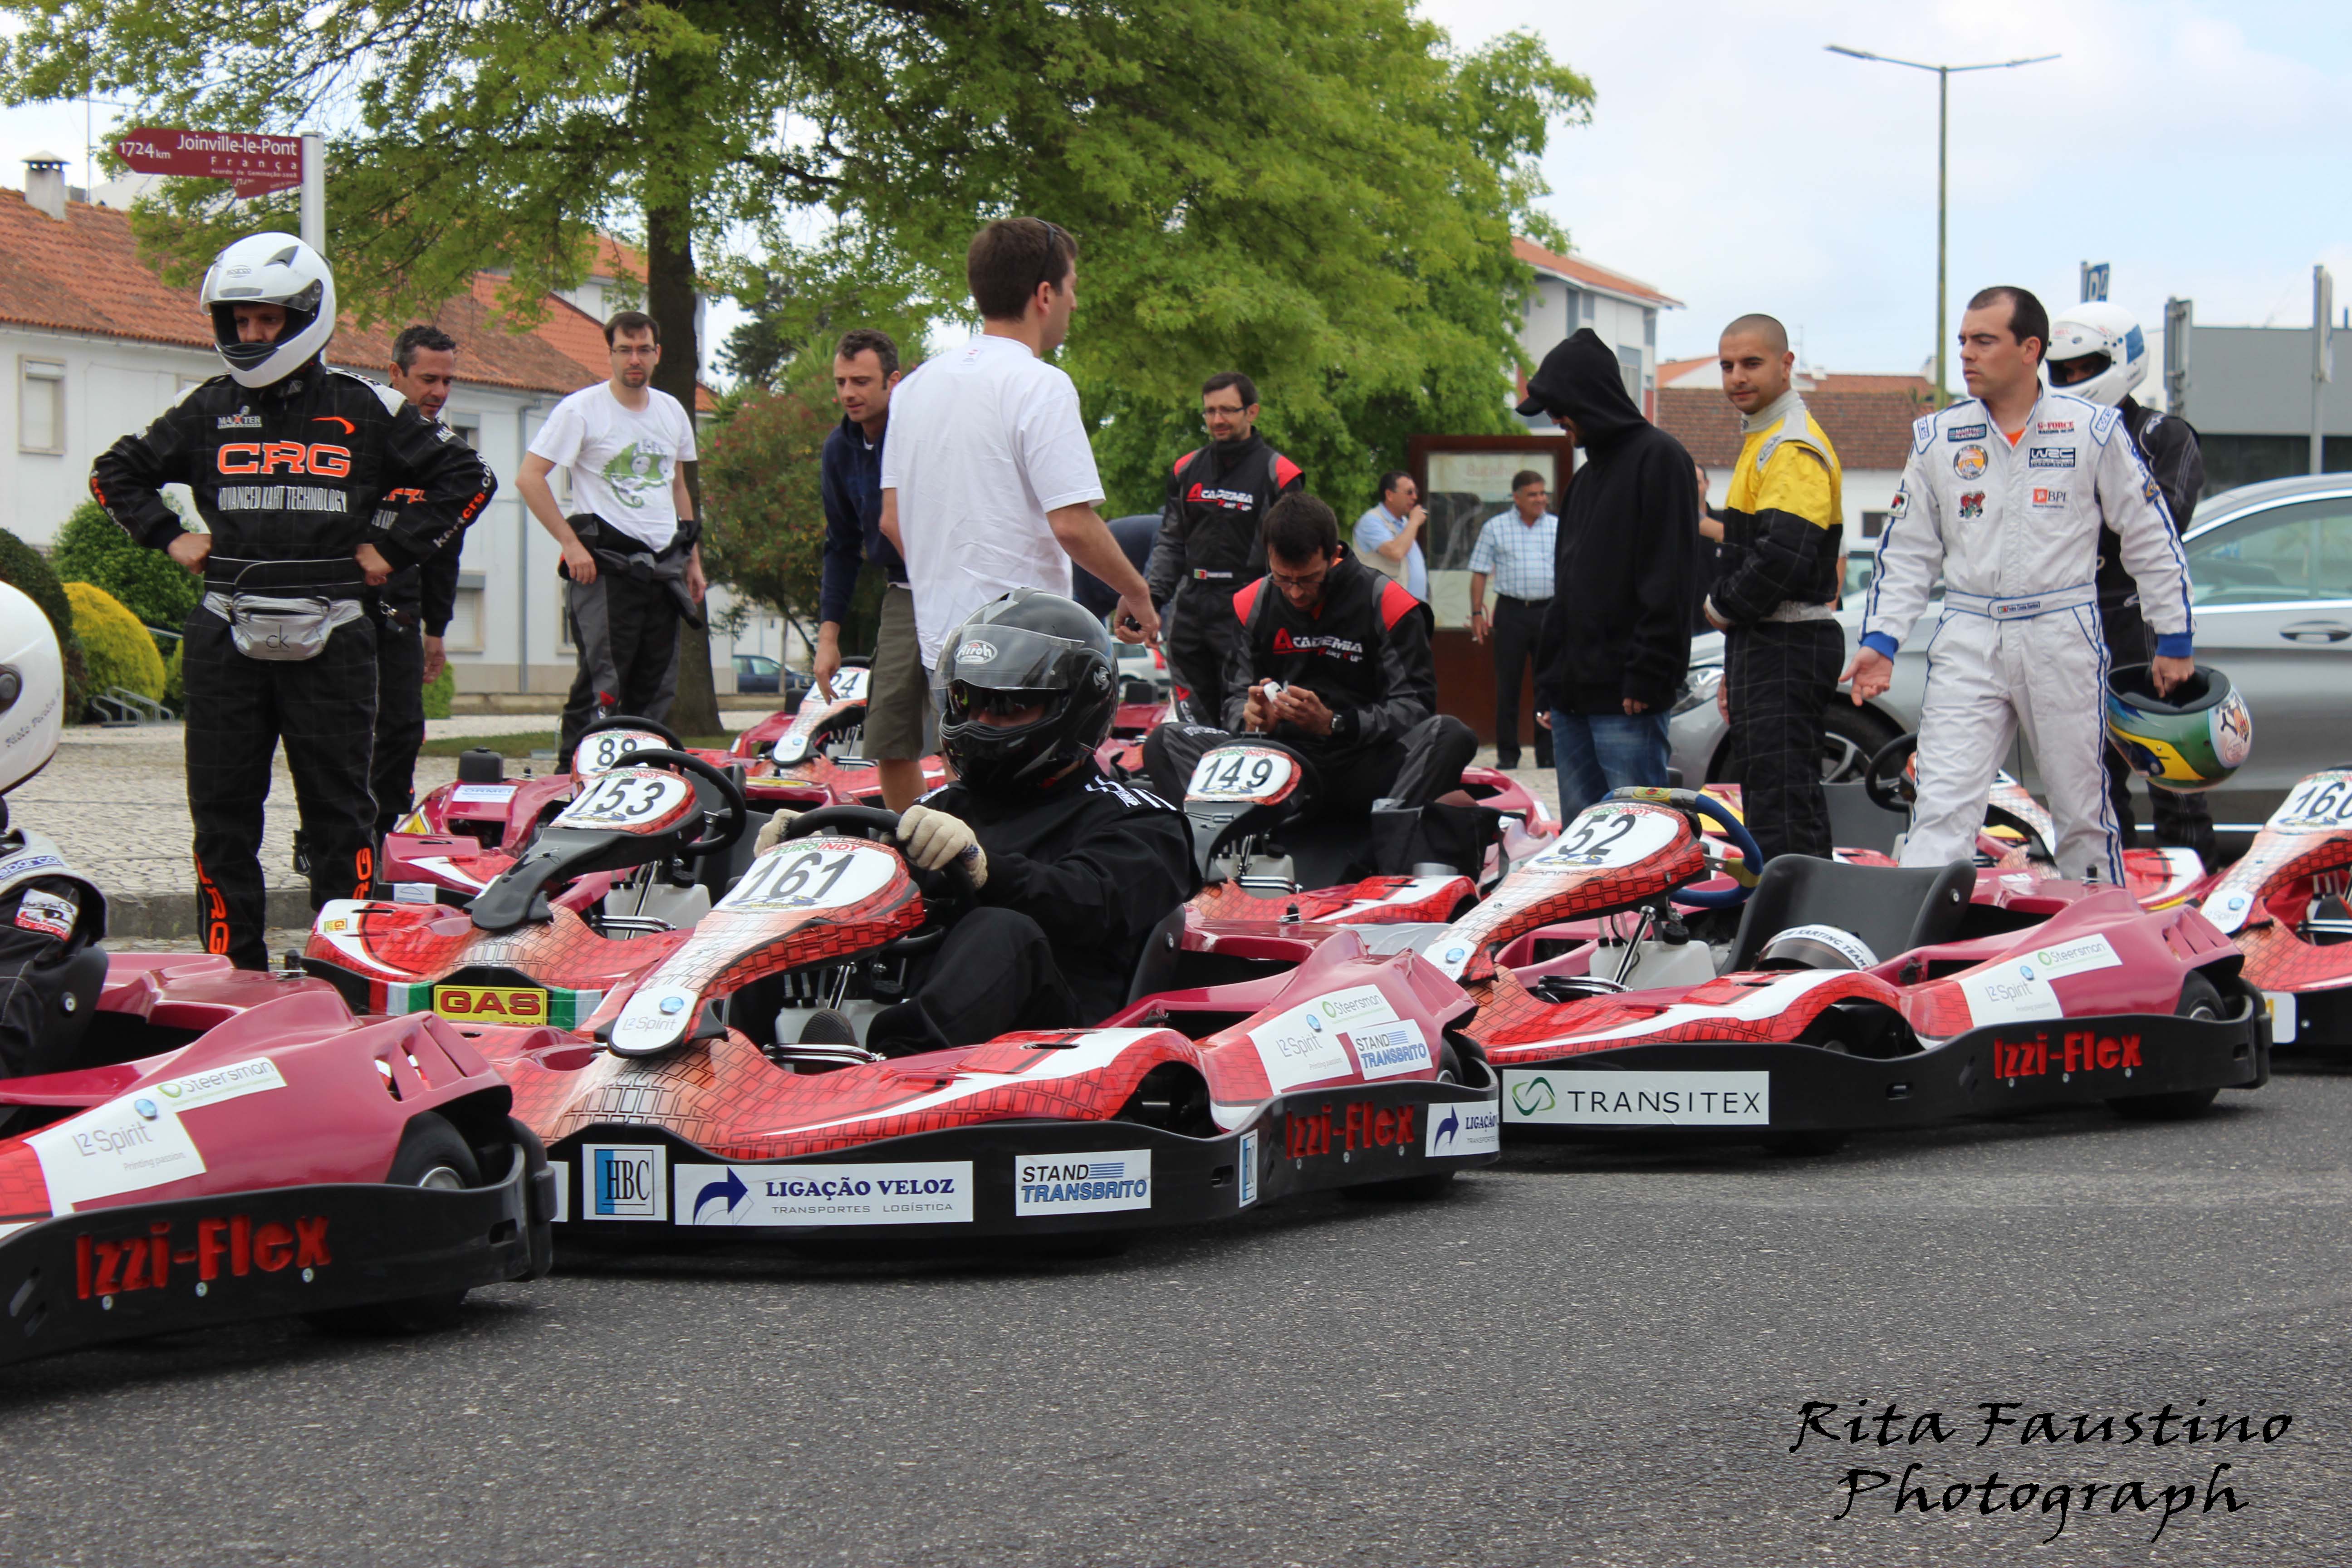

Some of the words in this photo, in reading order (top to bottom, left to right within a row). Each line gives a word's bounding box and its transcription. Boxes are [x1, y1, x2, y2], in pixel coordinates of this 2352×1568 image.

[119, 141, 154, 159] 1724
[156, 149, 171, 160] km
[176, 134, 297, 156] Joinville-le-Pont
[211, 156, 297, 171] França
[2037, 421, 2074, 429] G-FORCE
[217, 440, 351, 478] CRG
[2031, 448, 2074, 459] WRC
[218, 485, 262, 511] ADVANCED
[261, 485, 285, 510] KART
[286, 485, 348, 513] TECHNOLOGY
[2048, 490, 2067, 502] BPI
[266, 624, 290, 649] ck
[1273, 627, 1363, 653] ACADEMIA
[956, 643, 993, 658] Airoh
[1203, 755, 1273, 789] 149
[573, 778, 666, 816] 153
[1117, 790, 1138, 806] OMP
[1586, 807, 1652, 818] EUROINDY
[1558, 814, 1636, 856] 52
[771, 842, 862, 856] EUROINDY
[0, 856, 58, 880] sparco
[739, 851, 856, 900] 161
[1797, 929, 1842, 946] KARTING
[1842, 944, 1867, 967] TEAM
[2050, 943, 2106, 963] Steersman
[440, 990, 540, 1016] GAS
[1997, 980, 2033, 1002] Spirit
[1333, 995, 1383, 1015] Steersman
[635, 1016, 677, 1033] Spirit
[1288, 1031, 1323, 1057] Spirit
[1355, 1034, 1391, 1052] STAND
[1994, 1030, 2143, 1079] Izzi-Flex
[1361, 1043, 1427, 1069] TRANSBRITO
[180, 1061, 275, 1093] Steersman
[1567, 1090, 1760, 1114] TRANSITEX
[92, 1121, 153, 1156] Spirit
[1285, 1101, 1415, 1160] Izzi-Flex
[123, 1158, 155, 1171] Printing
[1022, 1164, 1089, 1183] STAND
[605, 1160, 650, 1201] HBC
[765, 1176, 871, 1201] LIGAÇÃO
[877, 1179, 955, 1196] VELOZ
[1021, 1179, 1147, 1203] TRANSBRITO
[771, 1205, 871, 1215] TRANSPORTES
[882, 1202, 953, 1212] LOGÍSTICA
[75, 1214, 332, 1300] Izzi-Flex
